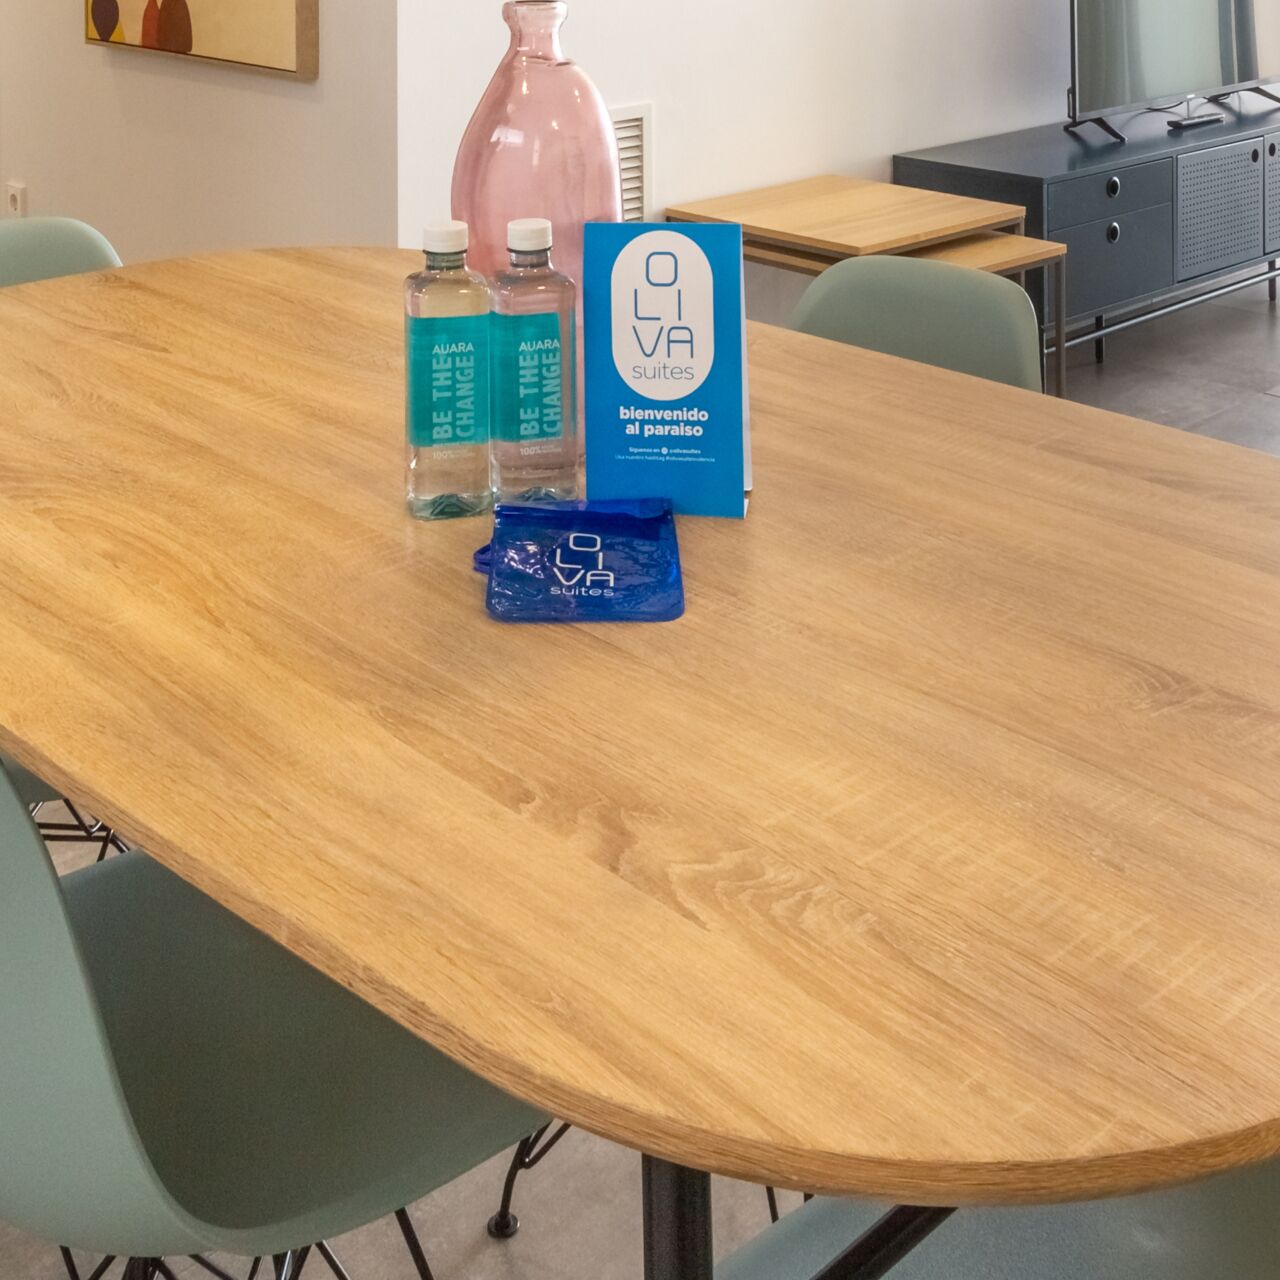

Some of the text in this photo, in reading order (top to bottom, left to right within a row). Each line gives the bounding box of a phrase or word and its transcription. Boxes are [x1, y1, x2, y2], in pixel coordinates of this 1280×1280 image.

[432, 342, 474, 354] AUARA
[518, 339, 560, 352] AUARA
[632, 361, 695, 380] suites
[432, 354, 453, 440] BE THE
[455, 355, 475, 438] CHANGE
[519, 352, 540, 436] BE THE
[541, 351, 561, 433] CHANGE
[619, 405, 709, 421] bienvenido
[625, 421, 640, 435] al
[550, 586, 615, 597] suites
